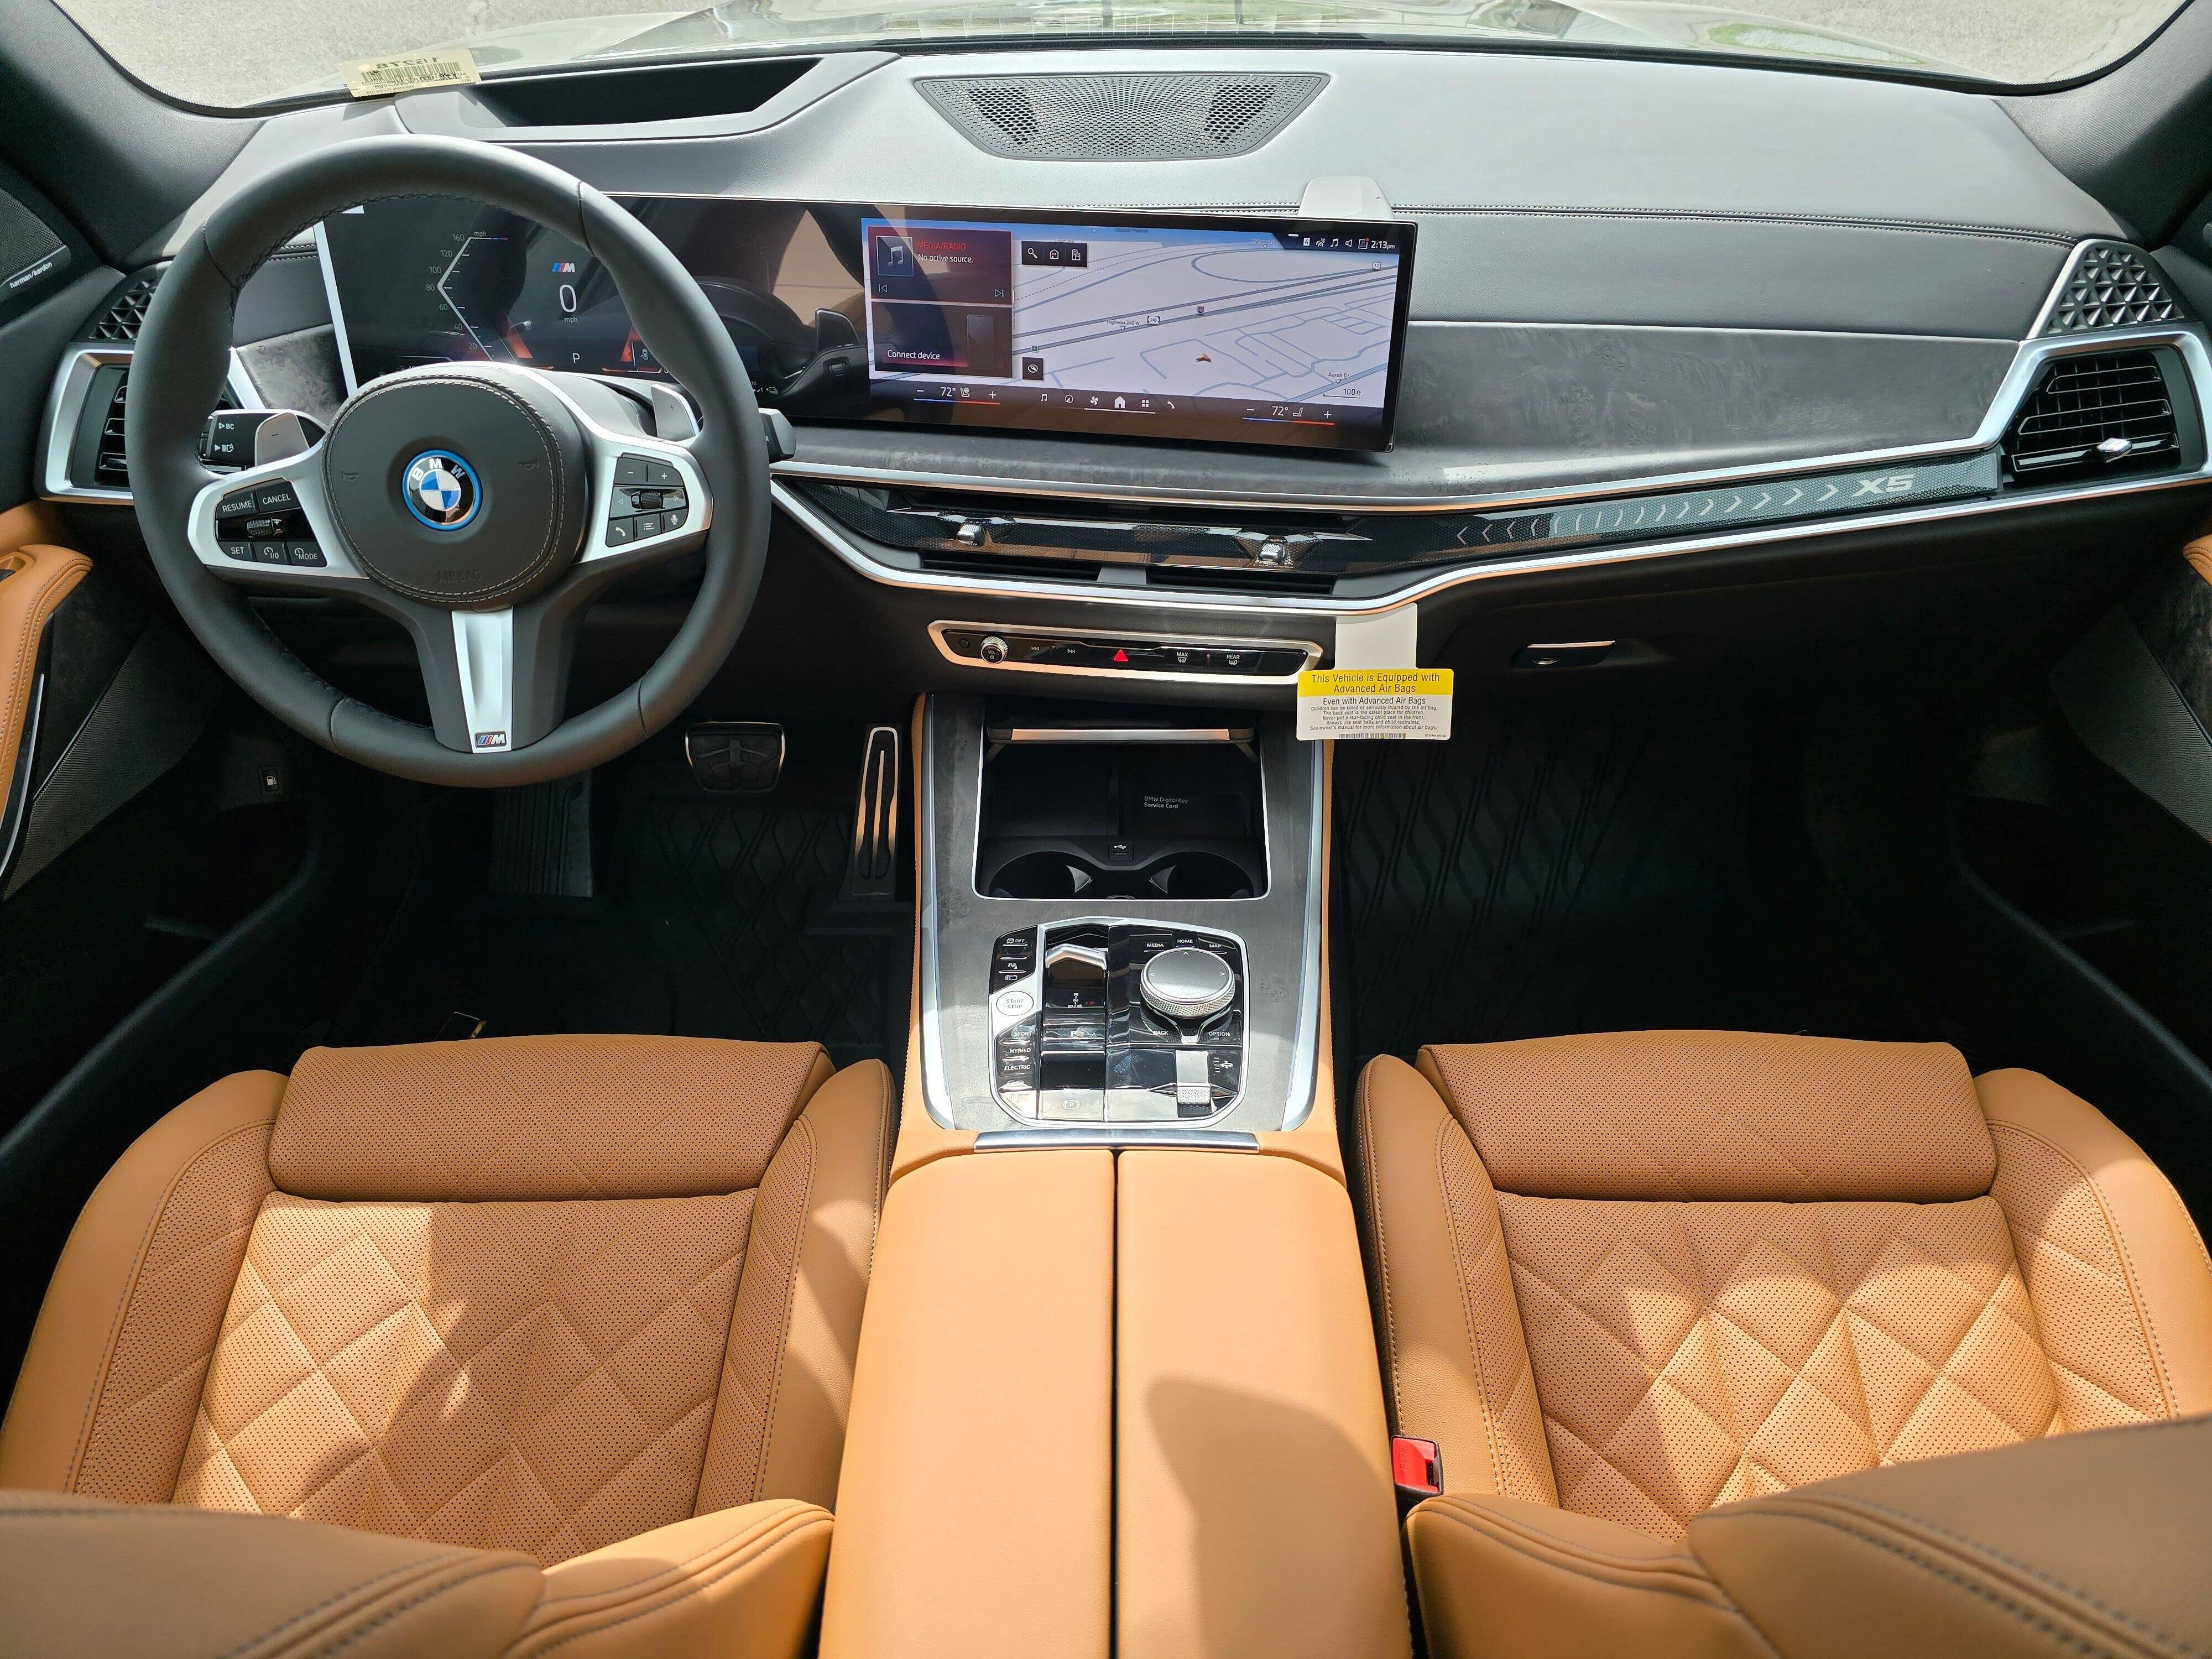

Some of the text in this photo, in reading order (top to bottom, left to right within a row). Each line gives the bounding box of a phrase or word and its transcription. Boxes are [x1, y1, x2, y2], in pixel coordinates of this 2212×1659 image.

[917, 241, 967, 251] MEDIA/RADIO
[1371, 241, 1395, 249] 2:13pm
[9, 262, 53, 288] harman/kardon
[560, 284, 577, 312] 0
[572, 353, 580, 364] P
[887, 349, 940, 360] Connect device
[411, 457, 466, 481] BMW
[1851, 473, 1916, 497] X5
[262, 493, 291, 505] CANCEL
[222, 500, 253, 513] RESUME
[231, 546, 244, 555] SET
[1312, 672, 1440, 683] This Vehicle is Equipped with
[1333, 684, 1416, 694] Advanced Air Bags
[1408, 696, 1426, 706] Bags
